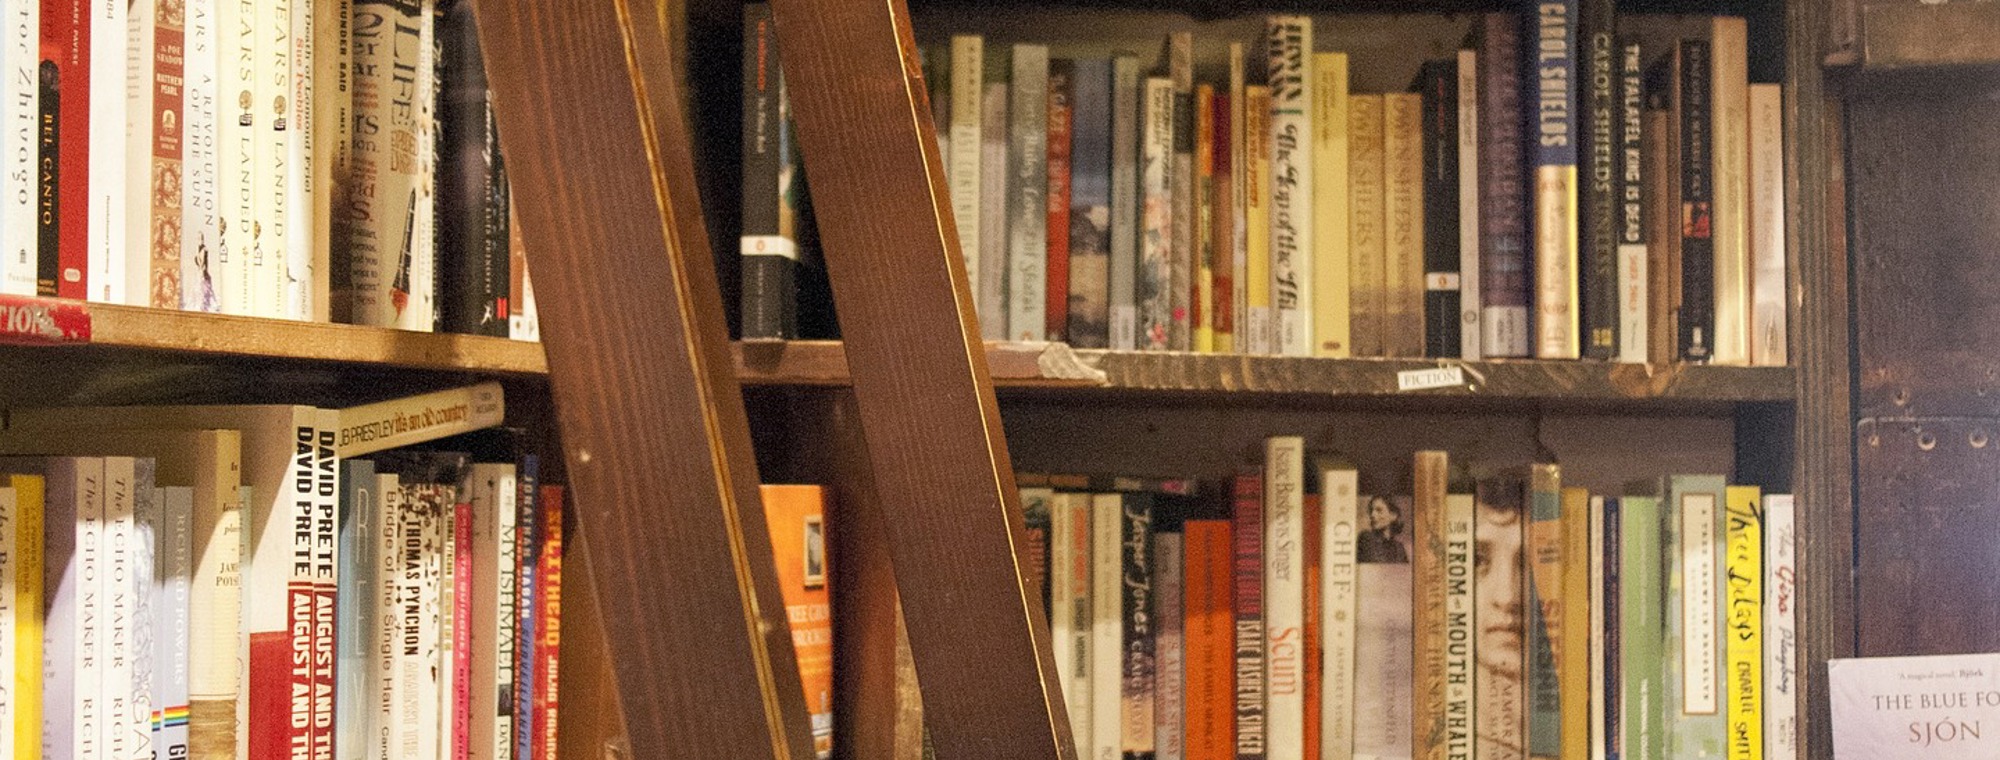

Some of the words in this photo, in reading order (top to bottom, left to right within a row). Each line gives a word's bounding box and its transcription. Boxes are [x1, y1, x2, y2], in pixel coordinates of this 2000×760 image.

[19, 0, 30, 54] tor
[275, 0, 288, 87] EARS
[296, 37, 304, 64] Sue
[304, 14, 313, 60] Death
[1539, 3, 1567, 63] CAROL
[304, 65, 311, 80] of
[1592, 32, 1610, 101] CAROL
[1624, 45, 1640, 72] THE
[192, 88, 200, 112] OF
[295, 72, 304, 131] Peebles
[304, 87, 312, 150] Lomond
[1539, 67, 1567, 147] SHIELDS
[1624, 77, 1641, 143] FALAFEL
[12, 66, 34, 205] Zhivago
[43, 114, 54, 147] BEL
[192, 122, 201, 159] THE
[1593, 108, 1611, 193] SHIELDS
[42, 157, 53, 225] CANTO
[192, 169, 201, 208] SUN
[203, 96, 213, 226] REVOLUTION
[240, 137, 251, 234] LANDED
[275, 142, 285, 237] LANDED
[304, 155, 312, 193] Friel
[1624, 150, 1640, 181] KING
[1625, 187, 1640, 201] IS
[1625, 204, 1640, 243] DEAD
[1404, 372, 1456, 386] FICTION
[297, 427, 315, 494] DAVID
[350, 418, 395, 444] PRIESTLEY
[83, 476, 96, 512] The
[318, 431, 336, 497] DAVID
[115, 478, 127, 512] The
[381, 491, 396, 553] Bridge
[522, 474, 533, 557] JONATHAN
[83, 517, 94, 582] ECHO
[114, 519, 124, 583] ECHO
[174, 514, 185, 599] RICHARD
[294, 501, 313, 577] PRETE
[317, 504, 334, 579] PRETE
[405, 520, 421, 580] THOMAS
[502, 523, 515, 562] MY
[1124, 508, 1151, 570] Jasper
[1271, 539, 1294, 582] Singer
[1333, 521, 1353, 593] CHEF
[1726, 502, 1760, 560] Three
[384, 580, 396, 607] the
[385, 556, 396, 574] of
[521, 566, 532, 620] RABAN
[546, 509, 561, 647] SPLITHEAD
[1448, 541, 1467, 596] FROM
[83, 593, 94, 670] MAKER
[113, 593, 123, 670] MAKER
[404, 587, 420, 656] PYNCHON
[499, 570, 515, 680] ISHMAEL
[1124, 575, 1149, 633] Jones
[1727, 567, 1758, 641] Delays
[173, 608, 184, 685] POWERS
[292, 593, 311, 678] AUGUST
[315, 594, 333, 678] AUGUST
[380, 614, 394, 671] Single
[1131, 640, 1143, 687] CRAIG
[1237, 620, 1262, 655] ISAAC
[1268, 626, 1302, 696] Scum
[1448, 612, 1467, 685] MOUTH
[1775, 626, 1792, 696] Playboy
[291, 682, 311, 729] AND
[315, 682, 332, 729] AND
[382, 678, 393, 715] Hair
[1237, 657, 1262, 711] BASHEVIS
[1736, 661, 1754, 715] CHARLIE
[1871, 694, 1914, 711] THE
[1920, 690, 1969, 709] BLUE
[83, 698, 93, 760] RICH
[113, 698, 123, 760] RICH
[133, 696, 151, 760] GA
[1237, 715, 1262, 755] SINGER
[1908, 715, 1981, 748] SJÓN
